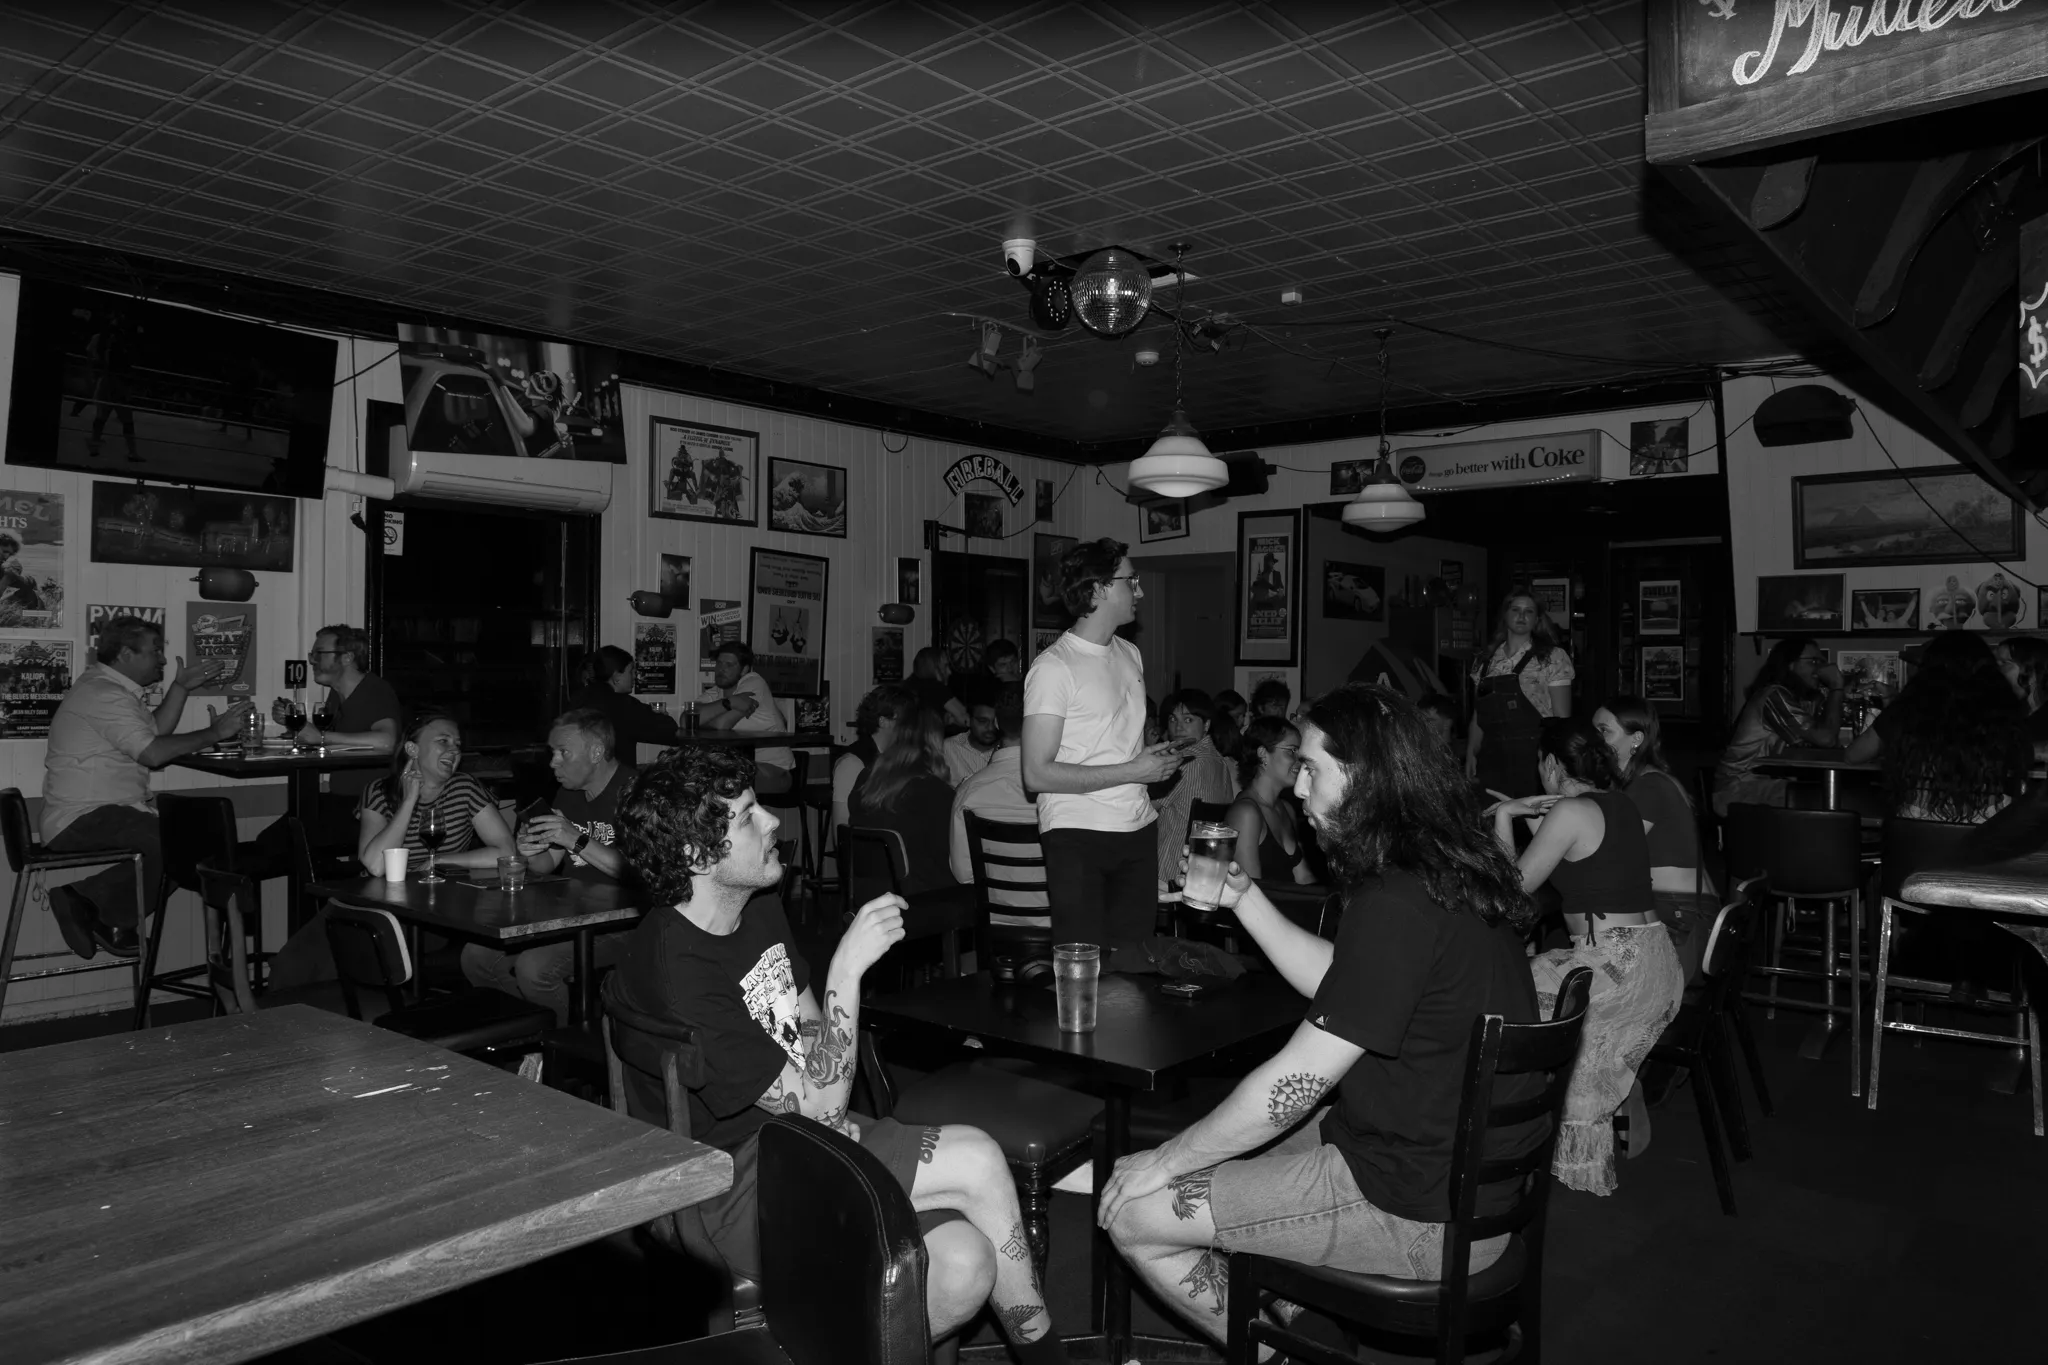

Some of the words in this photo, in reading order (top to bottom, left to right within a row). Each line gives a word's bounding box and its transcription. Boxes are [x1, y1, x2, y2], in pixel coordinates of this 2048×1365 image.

[1444, 468, 1454, 477] go
[1455, 462, 1489, 475] better
[1490, 452, 1526, 471] with
[1528, 446, 1585, 468] Coke
[946, 456, 1023, 503] FIREBALL
[701, 614, 717, 626] WIN
[288, 664, 304, 681] 10
